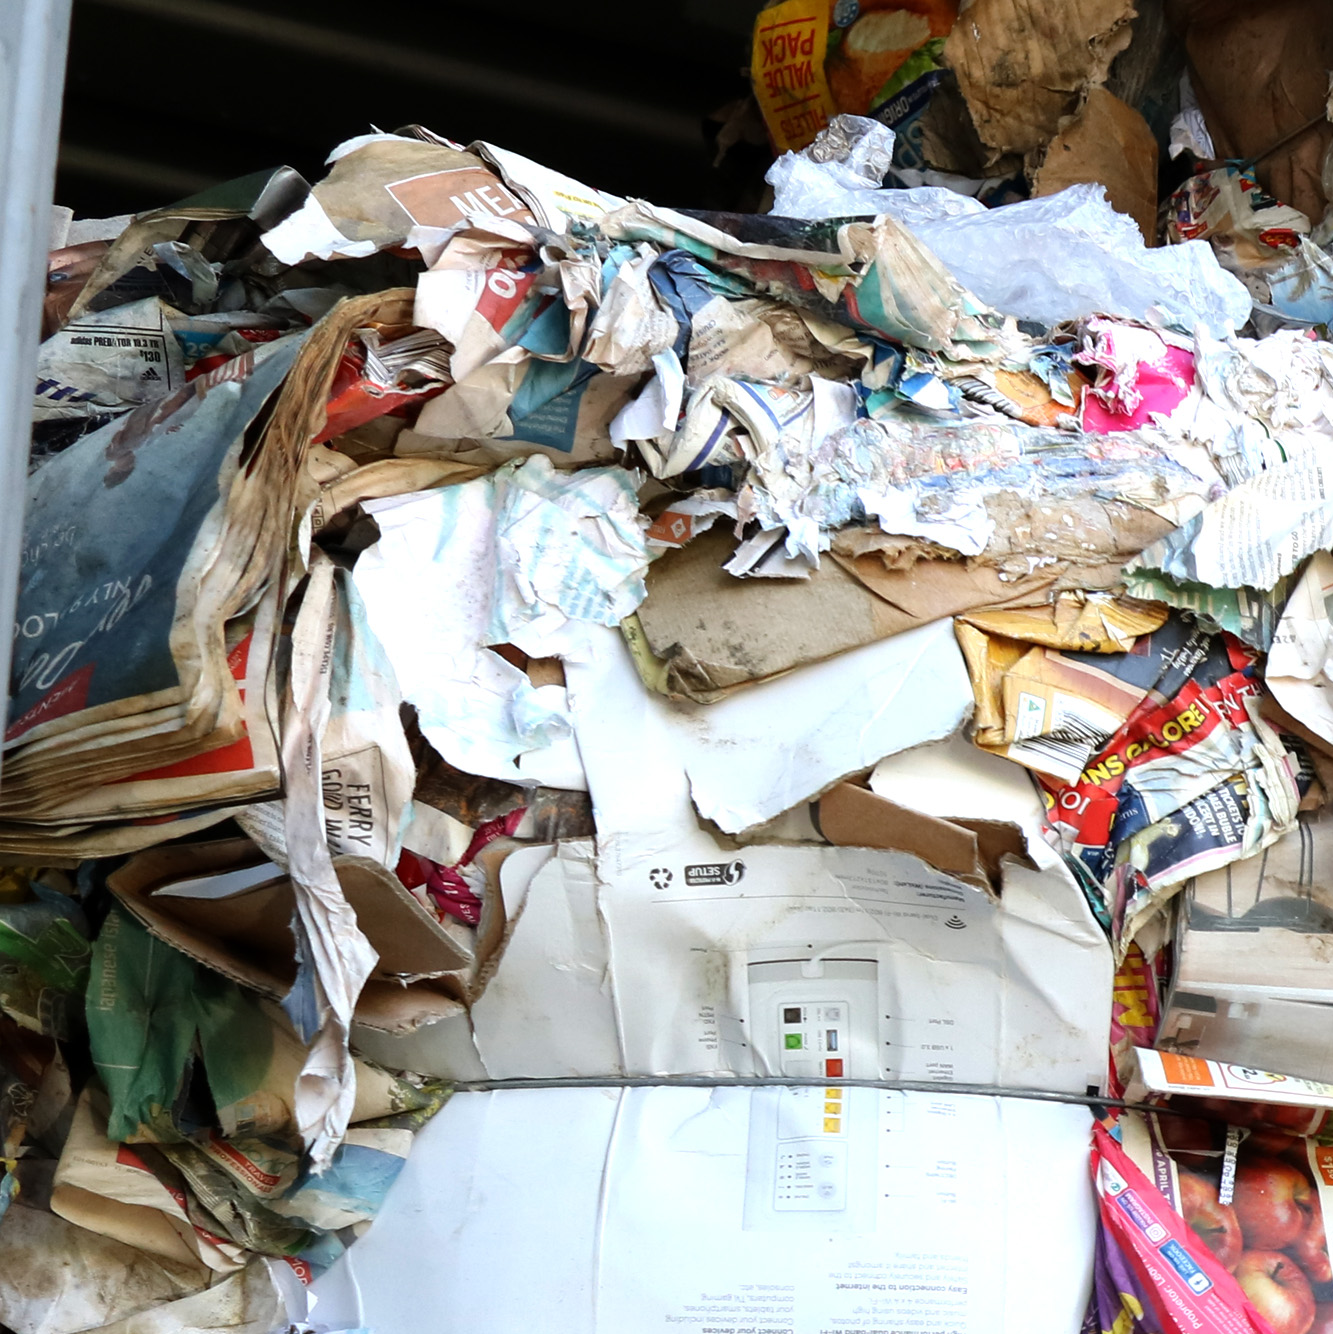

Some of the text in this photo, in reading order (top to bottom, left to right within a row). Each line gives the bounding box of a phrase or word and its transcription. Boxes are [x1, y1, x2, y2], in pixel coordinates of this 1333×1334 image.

[761, 29, 816, 67] PACK
[763, 60, 816, 98] VALUE
[70, 336, 92, 346] adidas
[139, 349, 161, 364] $130
[346, 783, 374, 847] FERRY
[688, 864, 721, 877] SETUP
[1156, 1159, 1168, 1190] APRIL
